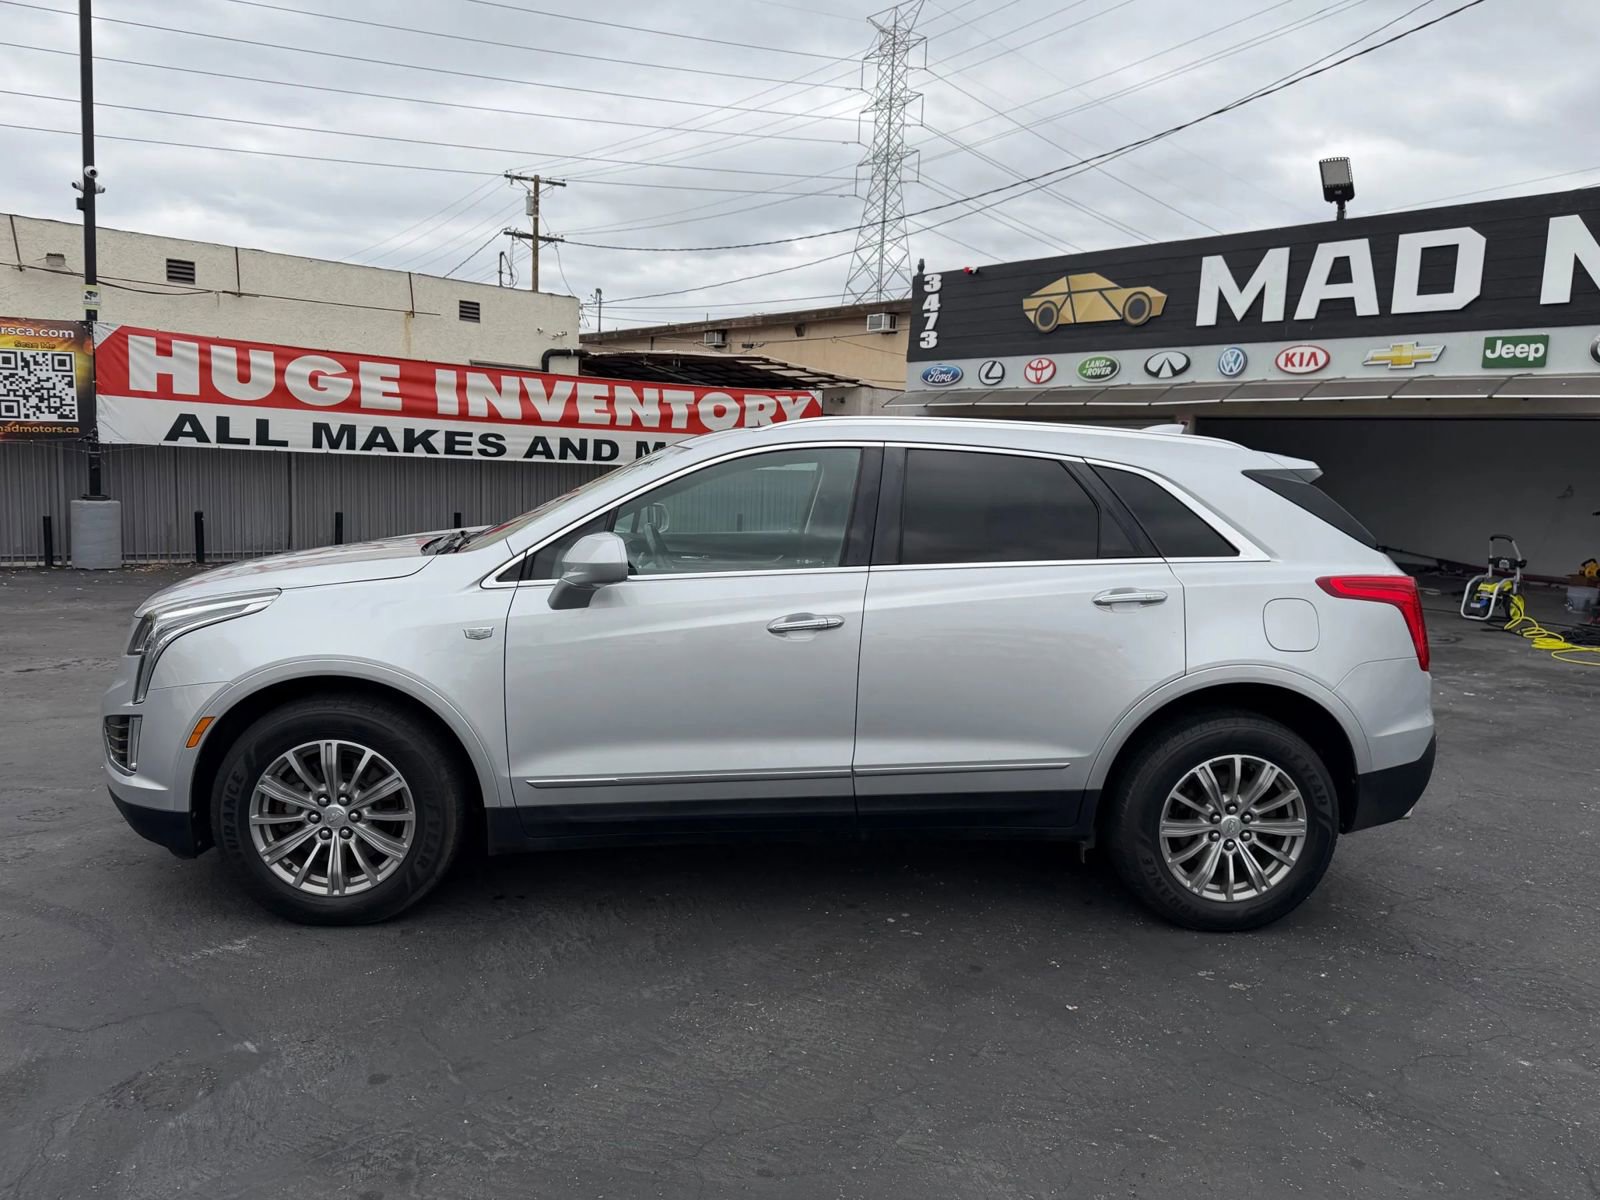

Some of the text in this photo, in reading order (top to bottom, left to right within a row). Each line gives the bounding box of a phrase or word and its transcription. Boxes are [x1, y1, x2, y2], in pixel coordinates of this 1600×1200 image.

[1195, 226, 1487, 327] MAD
[919, 273, 942, 349] 3473
[1283, 351, 1320, 368] KIA
[1485, 339, 1545, 361] Jeep
[927, 366, 953, 383] Ford
[1085, 359, 1106, 369] LAND
[1086, 366, 1112, 377] ROVER
[128, 334, 813, 432] HUGE INVENTORY
[163, 413, 289, 448] ALL
[312, 421, 507, 458] MAKES
[523, 435, 619, 461] AND
